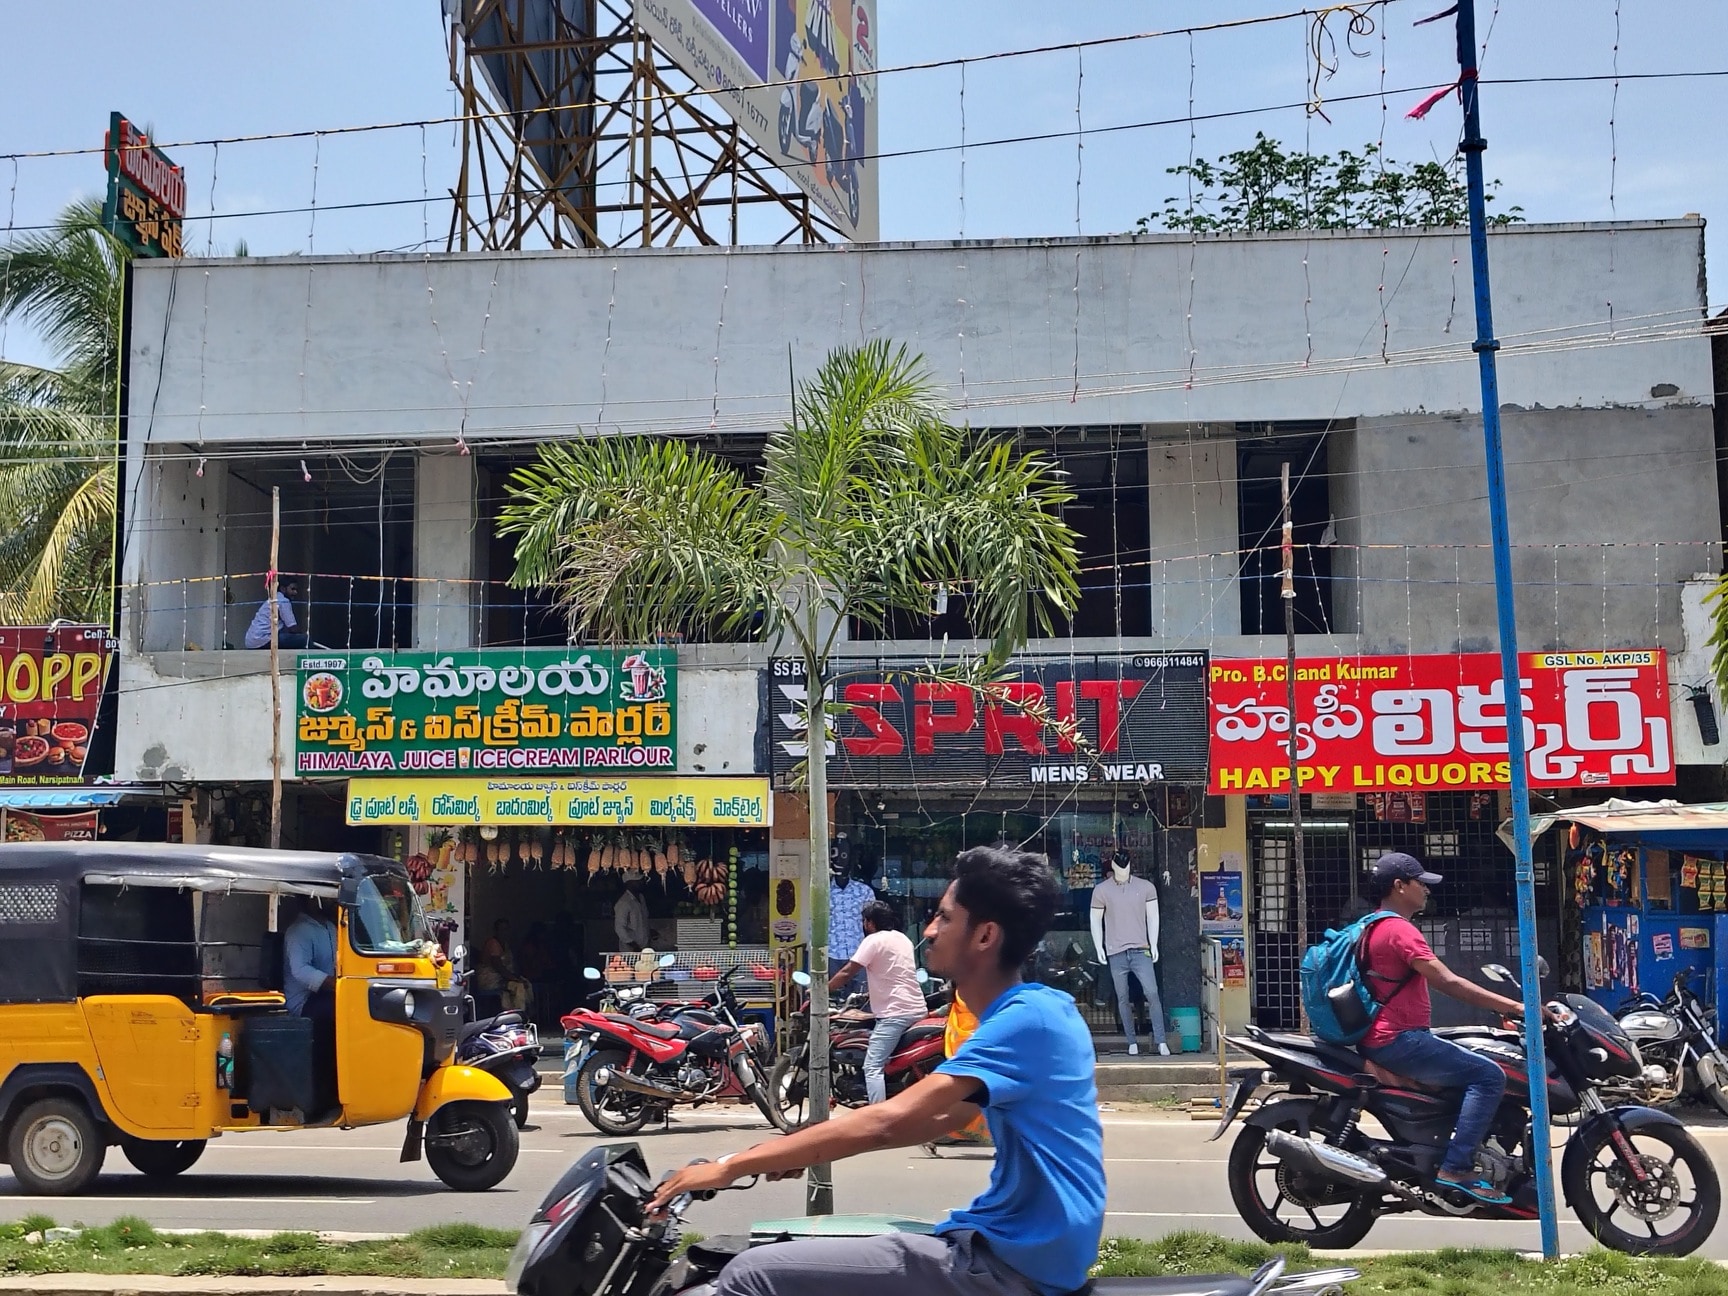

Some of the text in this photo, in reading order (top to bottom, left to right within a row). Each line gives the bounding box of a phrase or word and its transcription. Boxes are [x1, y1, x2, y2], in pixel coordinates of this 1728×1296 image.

[716, 0, 753, 43] ELLERS
[1545, 653, 1651, 666] GSL No. AKP/35
[362, 654, 610, 699] హిమాలయ
[1211, 666, 1248, 682] Pro.
[1337, 664, 1398, 681] Kumar
[299, 706, 395, 752] జ్యూస్
[570, 702, 672, 746] పార్లర్
[1216, 684, 1364, 760] హ్యాపీ
[299, 751, 397, 771] HIMALAYA
[400, 750, 456, 768] JUICE
[583, 746, 673, 768] PARLOUR
[17, 776, 38, 785] Road,
[39, 775, 85, 786] Narsipatnam
[1031, 763, 1164, 782] MENS WEAR
[1219, 761, 1512, 789] HAPPY LIQUORS
[63, 830, 93, 839] PIZZA
